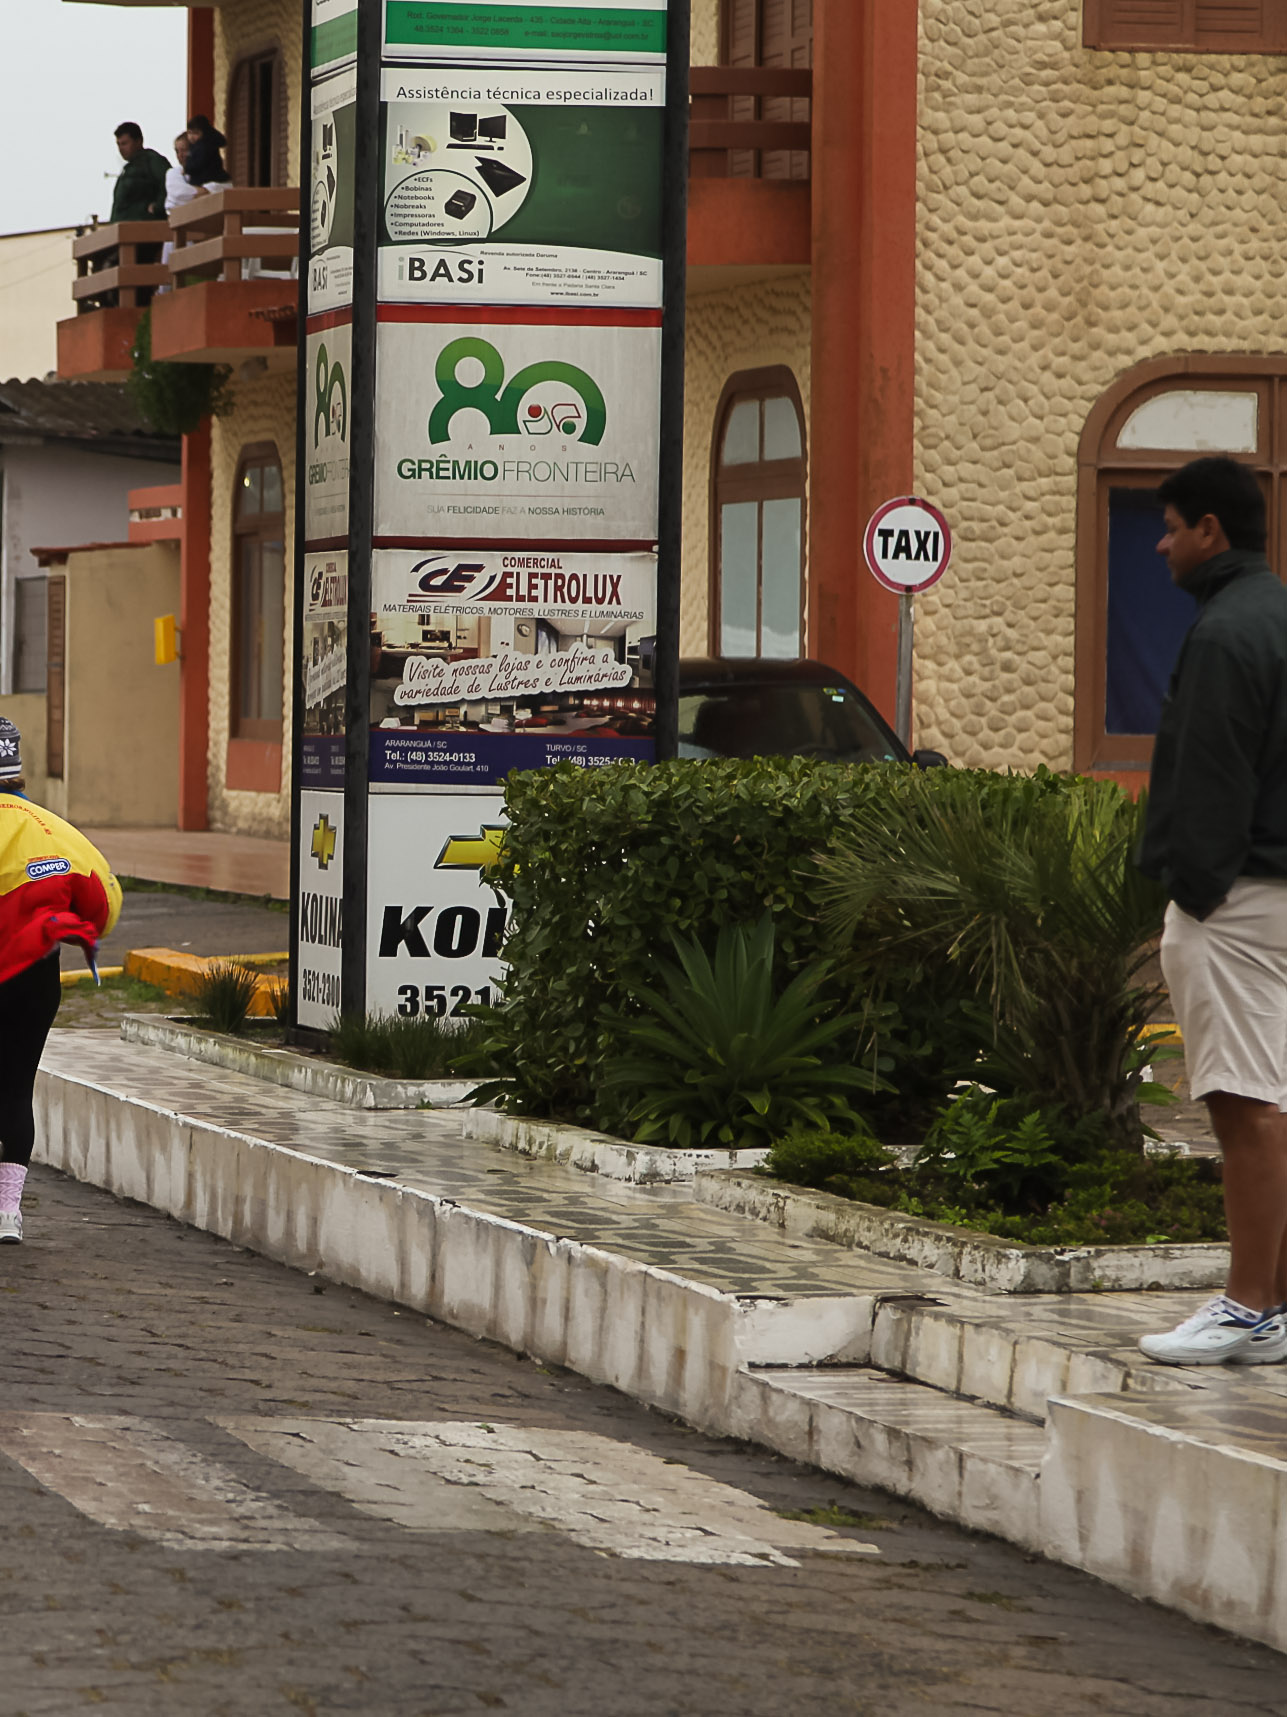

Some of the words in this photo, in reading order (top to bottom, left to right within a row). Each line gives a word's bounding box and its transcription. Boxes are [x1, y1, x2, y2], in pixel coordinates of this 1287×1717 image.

[396, 86, 481, 100] Assistência
[486, 87, 541, 101] técnica
[546, 88, 654, 103] especializada!
[458, 230, 480, 238] Linux)
[397, 454, 499, 482] GRÊMIO
[502, 459, 636, 483] FRONTEIRA
[427, 505, 445, 514] SUA
[447, 505, 500, 515] FELICIDADE
[528, 506, 560, 516] NOSSA
[561, 505, 605, 517] HISTÓRIA
[878, 528, 939, 562] TAXI
[501, 556, 563, 570] COMERCIAL
[489, 571, 623, 606] ELETROLUX
[382, 603, 431, 613] MATERIAIS
[432, 603, 487, 615] ELÉTRICOS,
[487, 606, 536, 618] MOTORES,
[537, 608, 580, 618] LUSTRES
[581, 609, 588, 618] E
[589, 608, 644, 620] LUMINÁRIAS
[409, 661, 445, 682] Visite
[451, 662, 493, 677] nossas
[498, 654, 531, 680] lojas
[536, 659, 543, 670] e
[550, 647, 596, 673] confira
[601, 652, 610, 664] a
[399, 678, 461, 699] variedade
[467, 676, 482, 694] de
[488, 674, 538, 692] Lustres
[544, 677, 553, 687] e
[558, 667, 627, 687] Luminárias
[385, 739, 432, 748] ARARANGUÁ
[437, 740, 448, 749] SC
[545, 743, 572, 752] TURVO
[576, 744, 588, 753] SC
[385, 750, 405, 761] Tel.:
[407, 751, 426, 763] (48)
[427, 751, 476, 762] 3524-0133
[396, 762, 432, 771] Presidente
[476, 764, 488, 772] 410
[30, 861, 67, 876] COMPER
